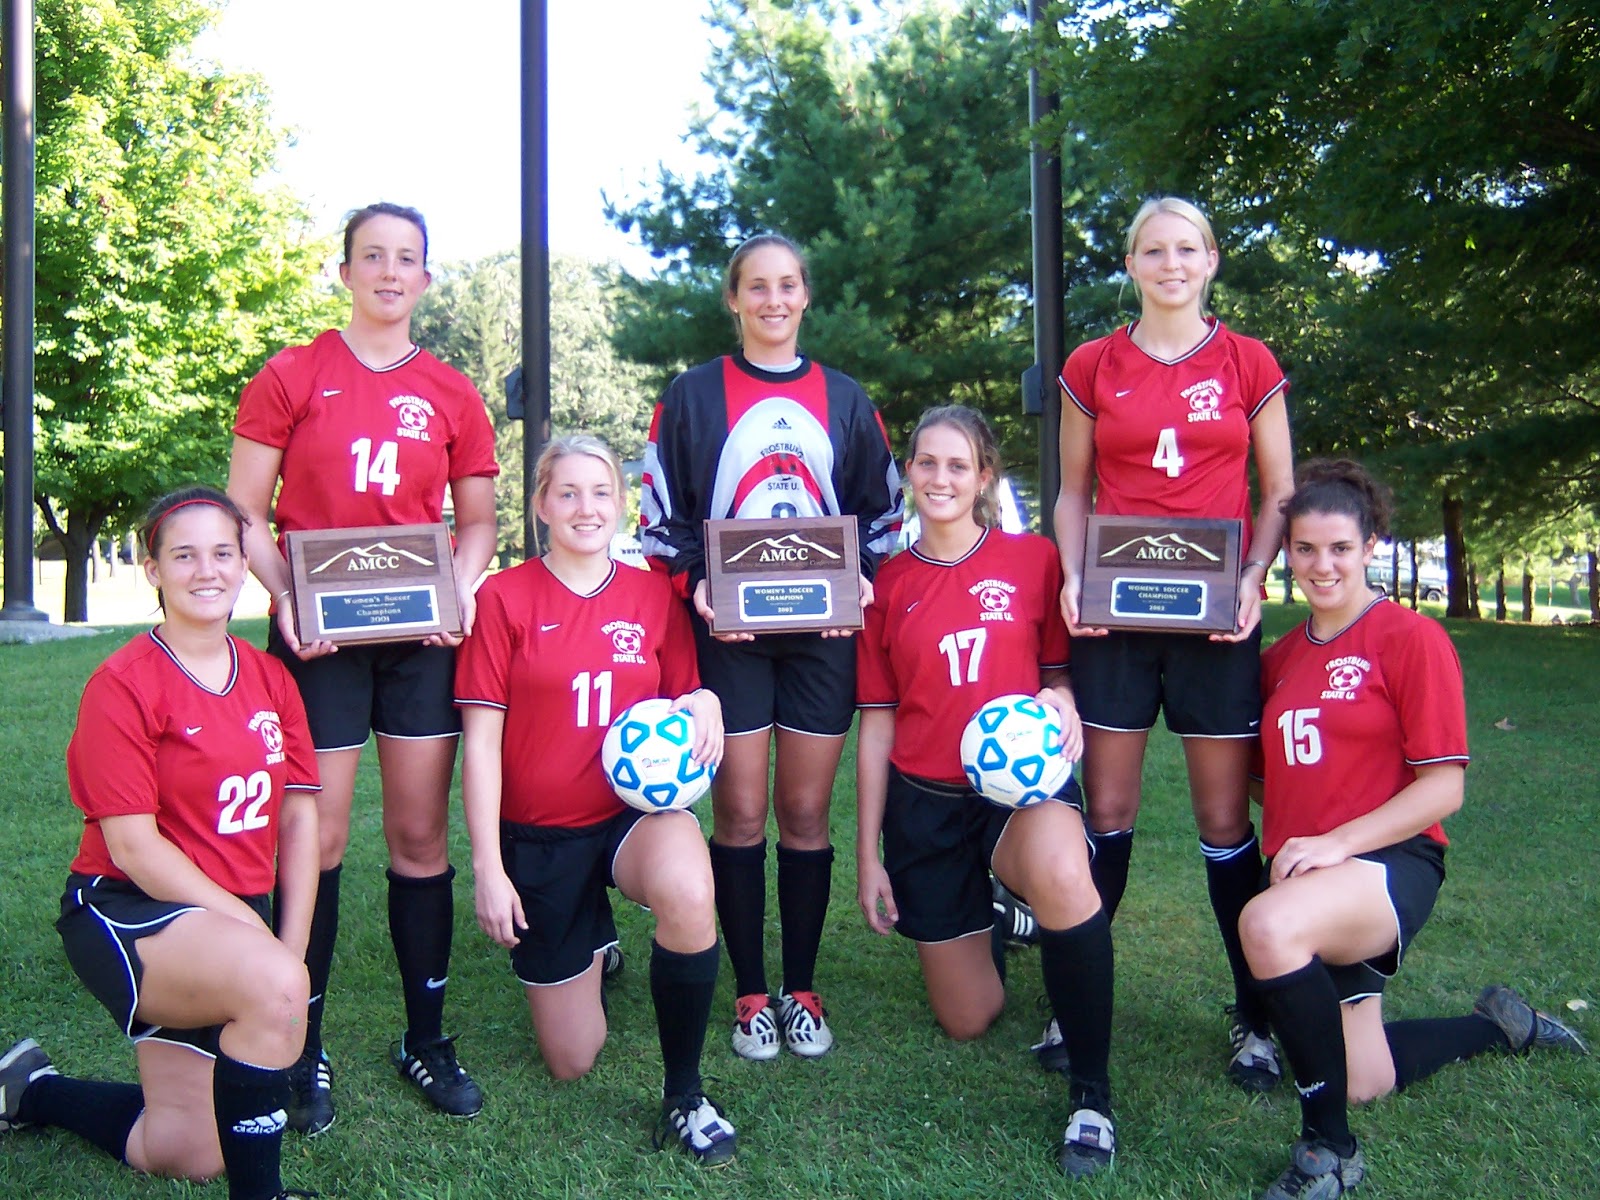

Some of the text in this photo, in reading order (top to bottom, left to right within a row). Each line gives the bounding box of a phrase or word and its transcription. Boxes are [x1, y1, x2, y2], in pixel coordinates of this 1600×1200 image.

[1187, 410, 1211, 423] STATE
[396, 427, 420, 440] STATE
[1152, 428, 1184, 478] 4
[351, 438, 401, 496] 14
[767, 482, 789, 491] STATE
[759, 548, 809, 562] AMCC
[1135, 547, 1188, 561] AMCC
[347, 556, 400, 572] AMCC
[1138, 592, 1178, 601] CHAMPIONS
[1163, 586, 1189, 594] SOCCER
[980, 611, 1003, 621] STATE
[612, 653, 636, 664] STATE
[938, 626, 987, 687] 17
[572, 671, 613, 727] 11
[1320, 690, 1345, 700] STATE
[1277, 707, 1322, 766] 15
[217, 770, 272, 835] 22
